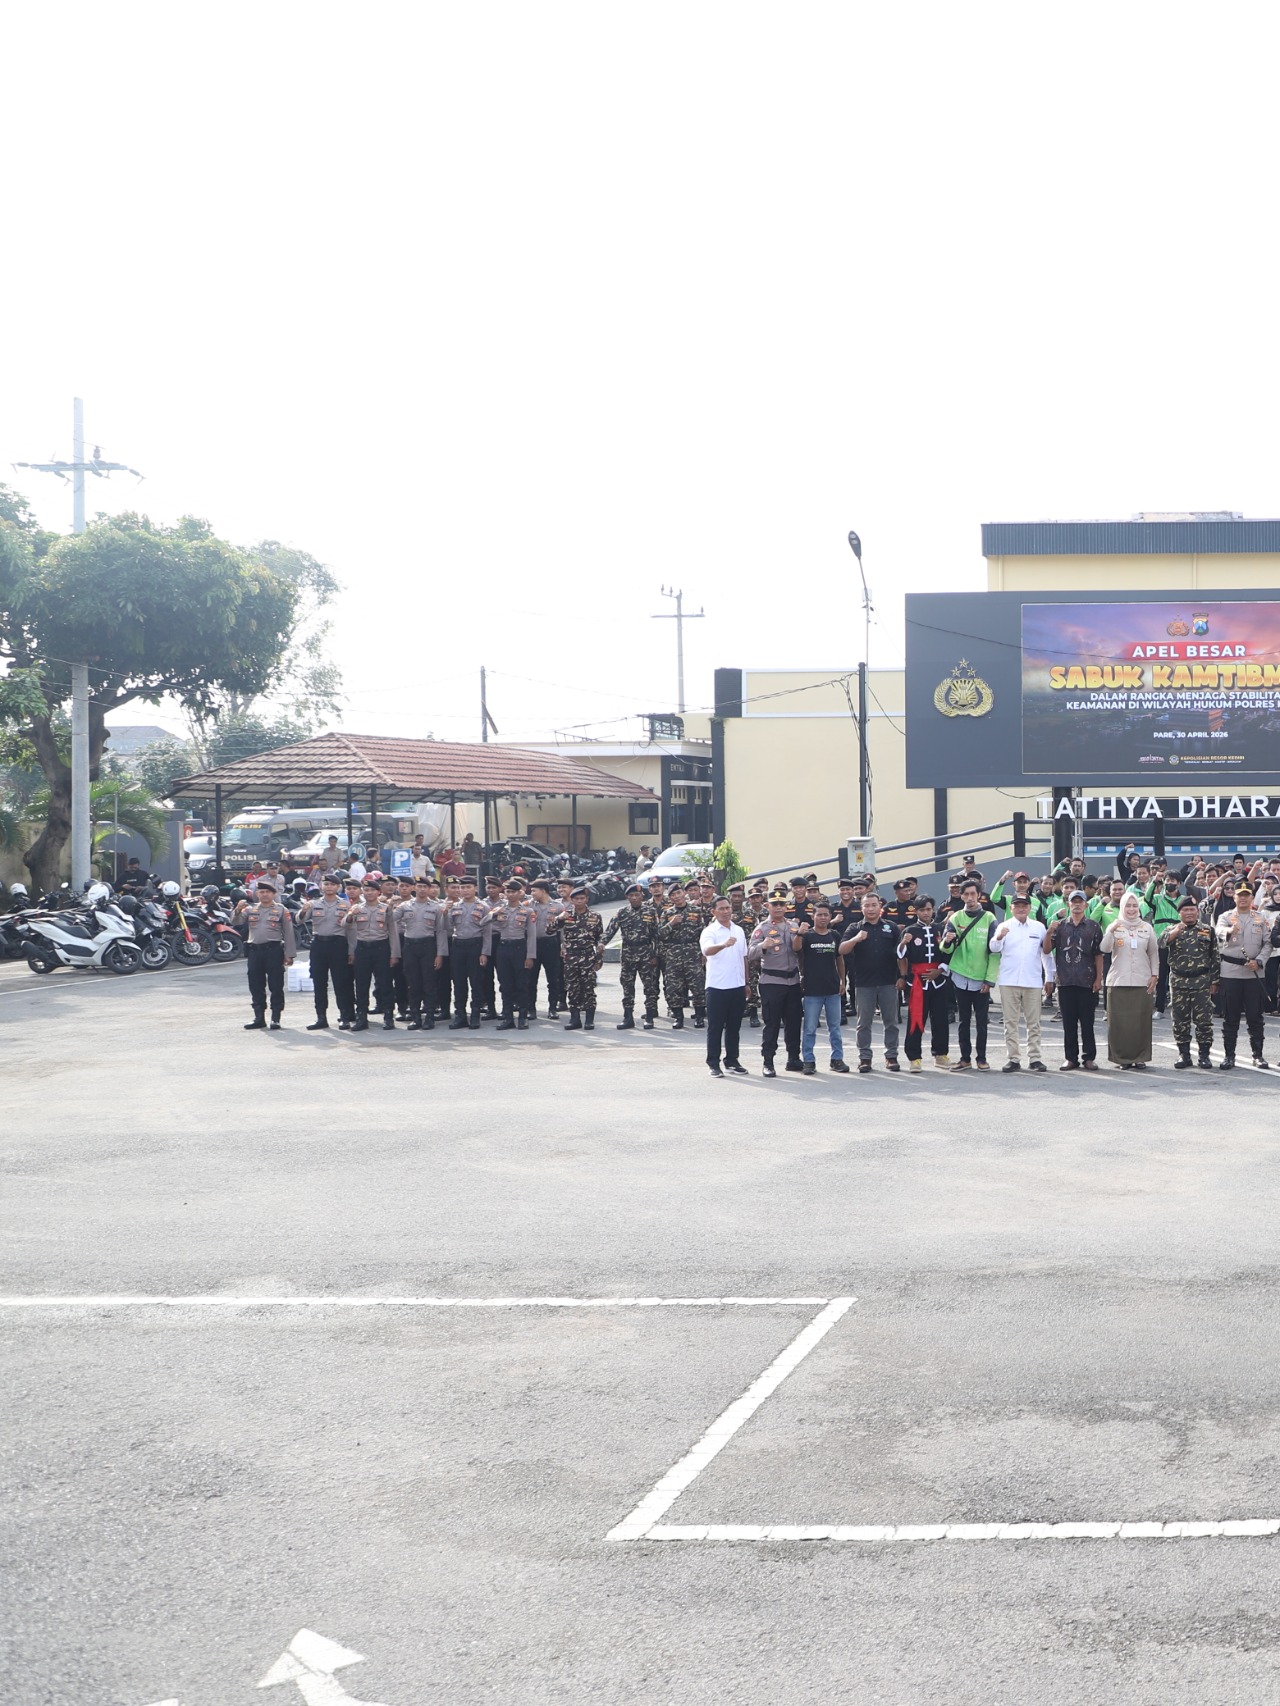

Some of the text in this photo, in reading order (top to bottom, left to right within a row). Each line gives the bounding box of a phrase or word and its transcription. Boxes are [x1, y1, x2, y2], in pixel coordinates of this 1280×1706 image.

[1132, 645, 1246, 658] APEL BESAR
[1049, 665, 1143, 689] SABUK
[1090, 692, 1128, 701] DALAM
[1130, 692, 1174, 701] RANGKA
[1176, 692, 1227, 701] MENJAGA
[1066, 701, 1126, 710] KEAMANAN
[1128, 701, 1140, 709] DI
[1142, 701, 1191, 709] WILAYAH
[1194, 701, 1232, 709] HUKUM
[1234, 700, 1275, 709] POLRES
[1036, 796, 1163, 819] TATHYA
[394, 851, 409, 867] P
